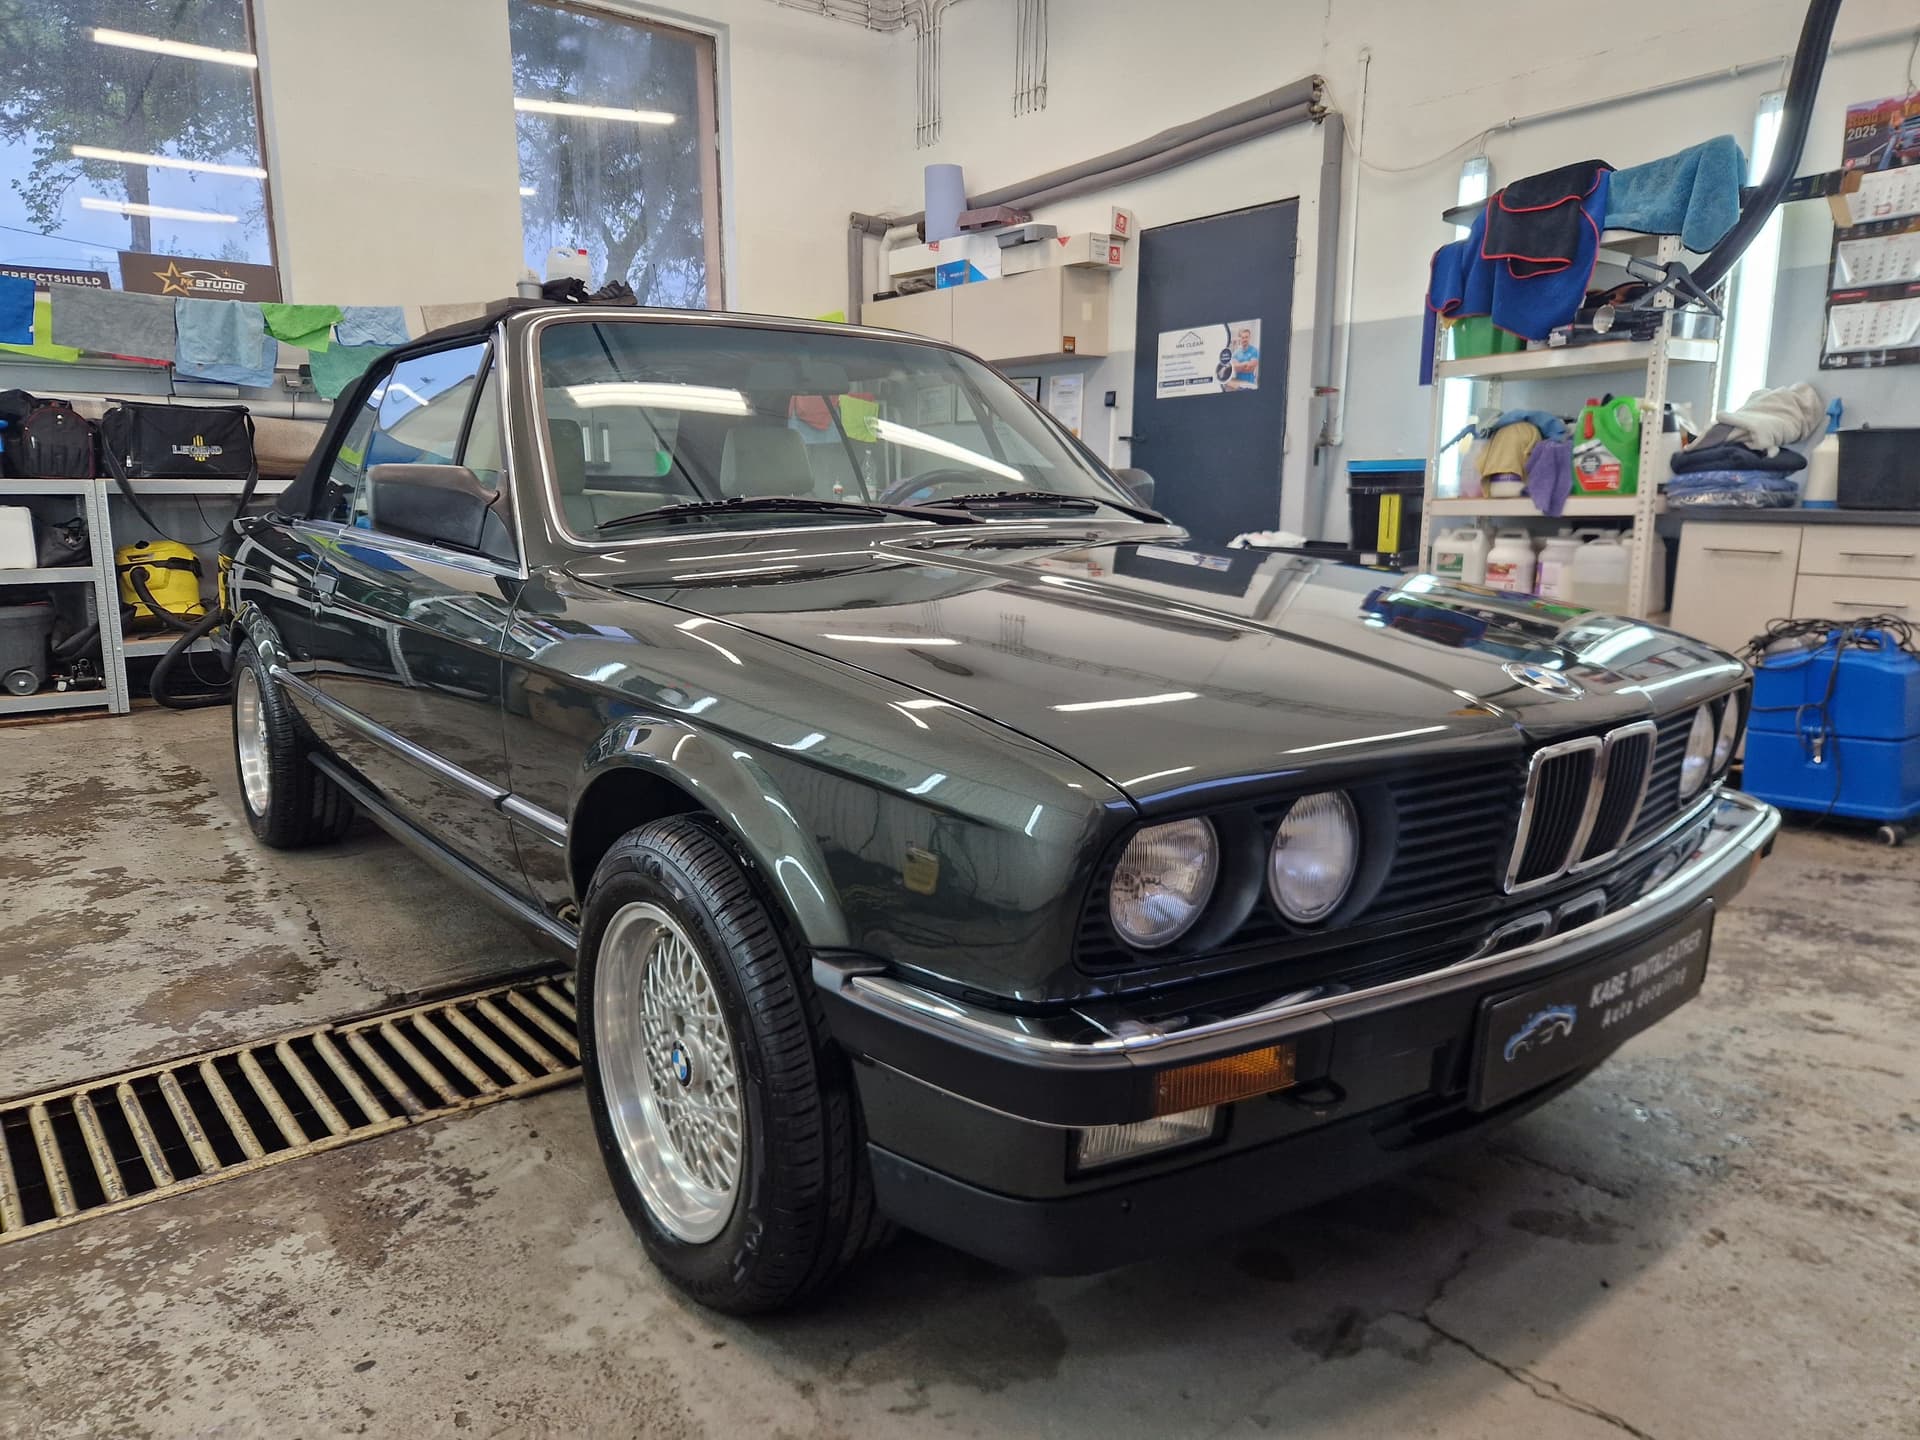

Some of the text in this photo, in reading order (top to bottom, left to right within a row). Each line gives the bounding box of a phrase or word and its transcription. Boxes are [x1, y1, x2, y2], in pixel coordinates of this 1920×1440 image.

[1847, 124, 1877, 141] 2025
[0, 270, 101, 285] ERFECTSHIELD
[195, 279, 245, 291] STUDIO
[1602, 1000, 1633, 1029] Auto
